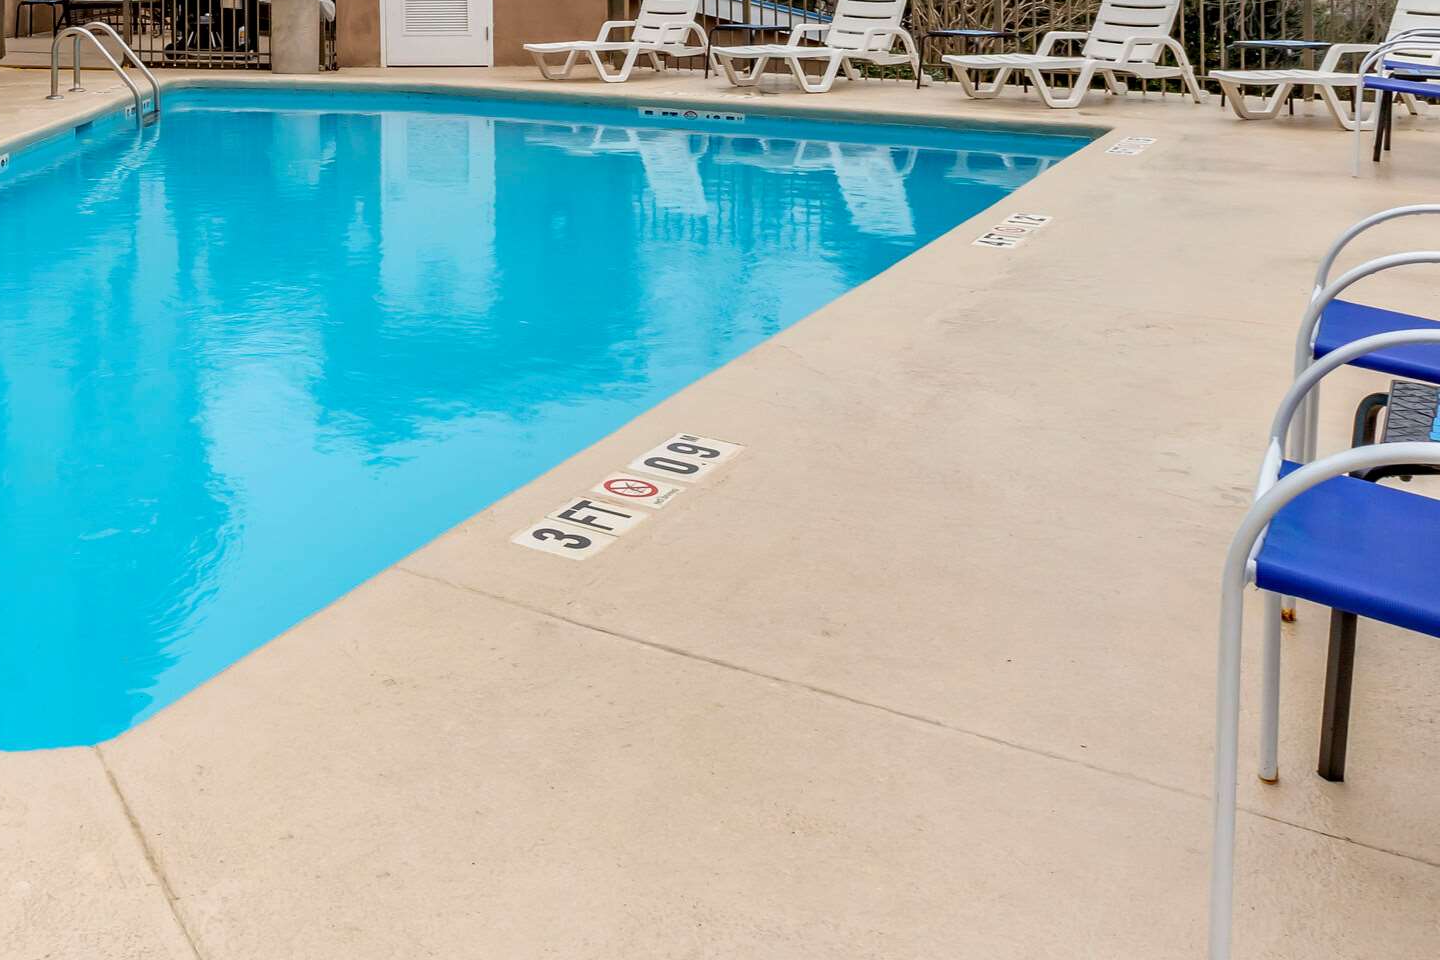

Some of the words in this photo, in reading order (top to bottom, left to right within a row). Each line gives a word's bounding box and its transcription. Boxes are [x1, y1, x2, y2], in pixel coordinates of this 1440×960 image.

[643, 442, 721, 475] 0.9
[557, 499, 632, 531] FT
[532, 528, 592, 550] 3
